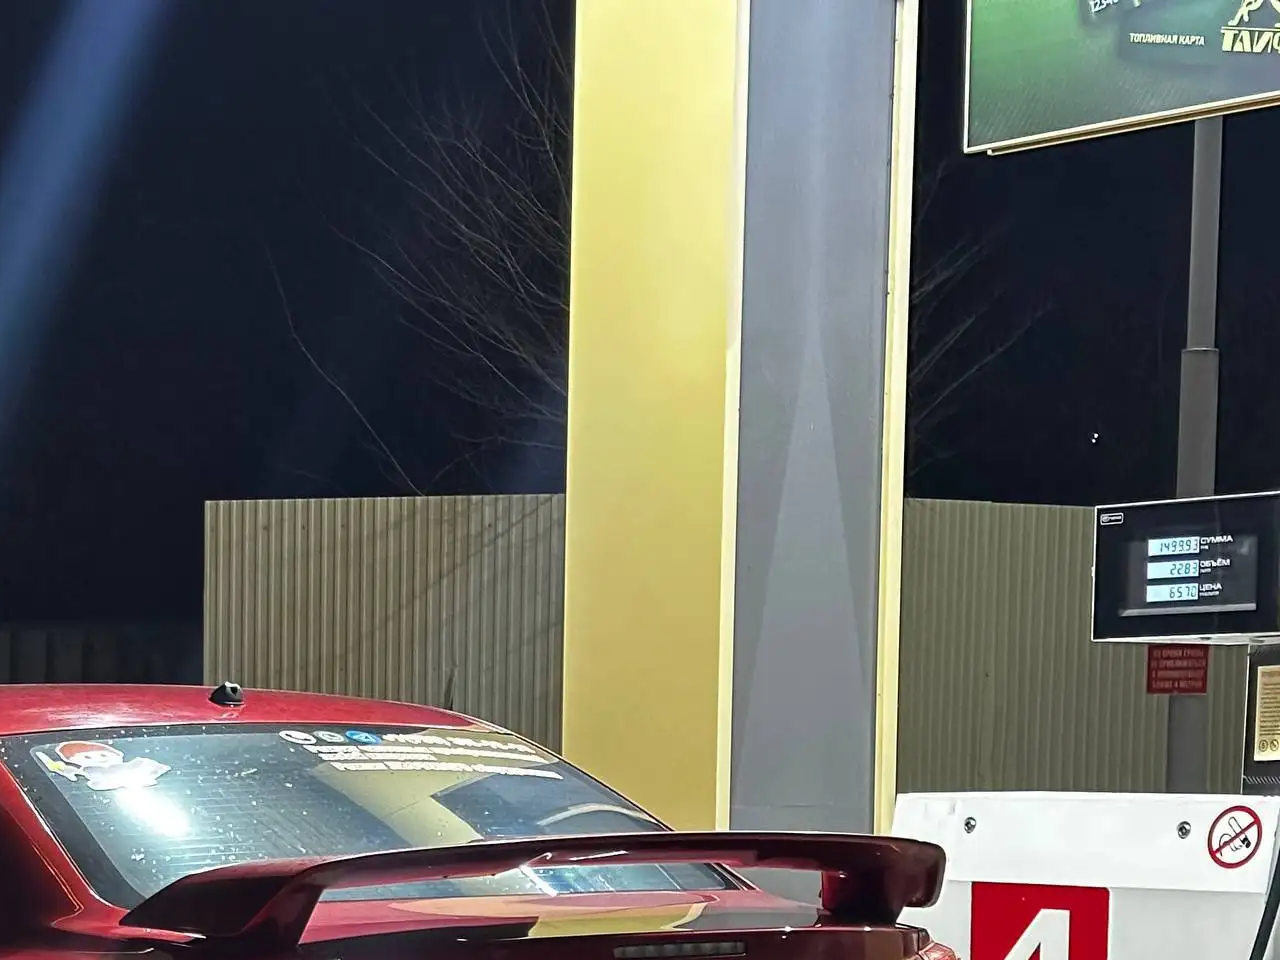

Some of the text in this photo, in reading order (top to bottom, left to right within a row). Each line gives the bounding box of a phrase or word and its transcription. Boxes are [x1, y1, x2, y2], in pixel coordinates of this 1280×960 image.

[1129, 32, 1206, 46] ТОПЛИВНАЯ КАРТА
[1200, 534, 1234, 544] СУММА
[1199, 582, 1223, 592] ЦЕНА
